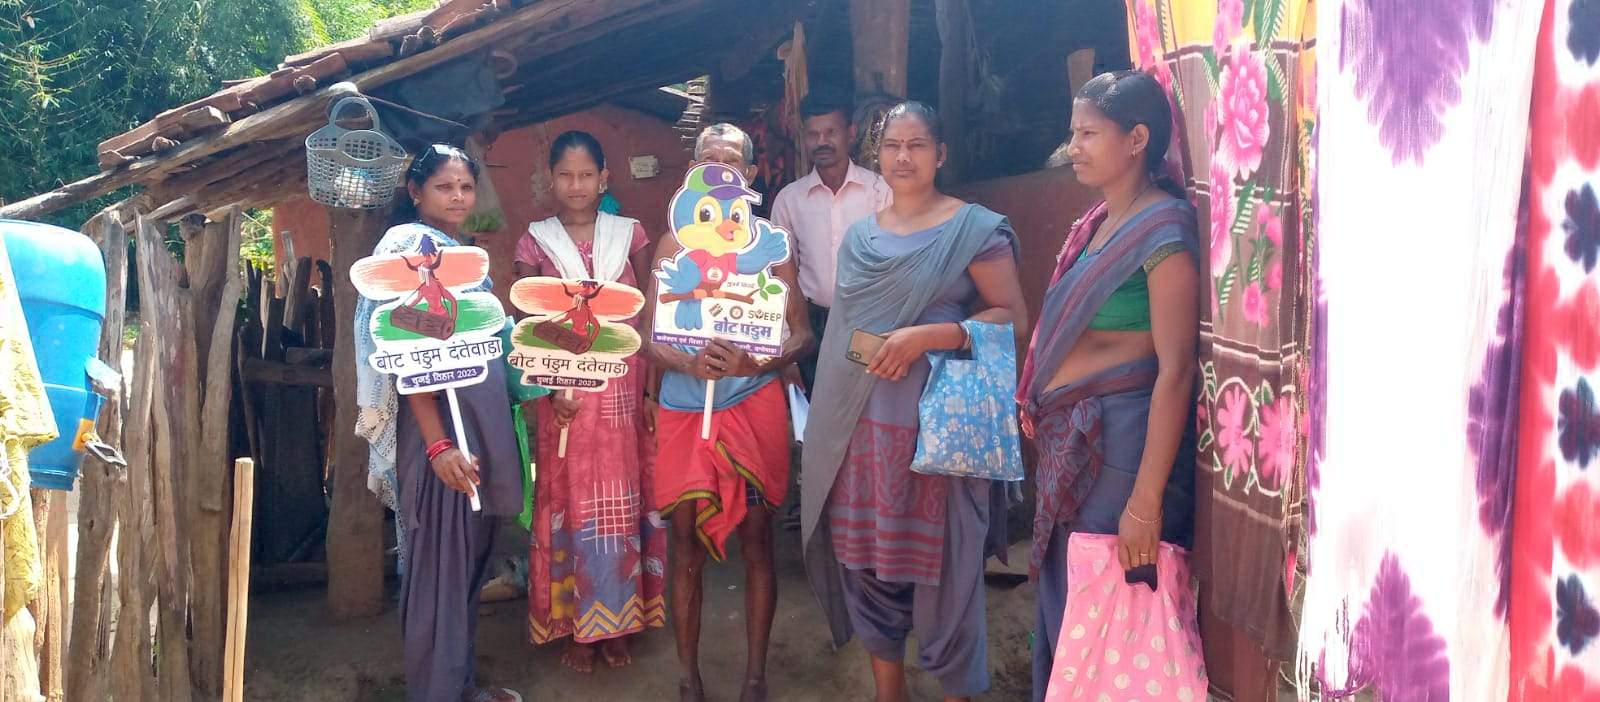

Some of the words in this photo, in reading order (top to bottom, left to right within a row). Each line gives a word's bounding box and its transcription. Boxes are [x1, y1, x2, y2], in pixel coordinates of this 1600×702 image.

[713, 316, 739, 334] बोट
[740, 321, 772, 340] पंडुम
[375, 351, 404, 370] बोट
[410, 346, 442, 369] पंडुम
[447, 340, 501, 360] दंतेवाड़ा
[509, 353, 537, 368] बोट
[541, 354, 571, 373] पंडुम
[577, 357, 627, 377] दंतेवाड़ा
[457, 368, 477, 379] 2023
[578, 379, 597, 387] 2023
